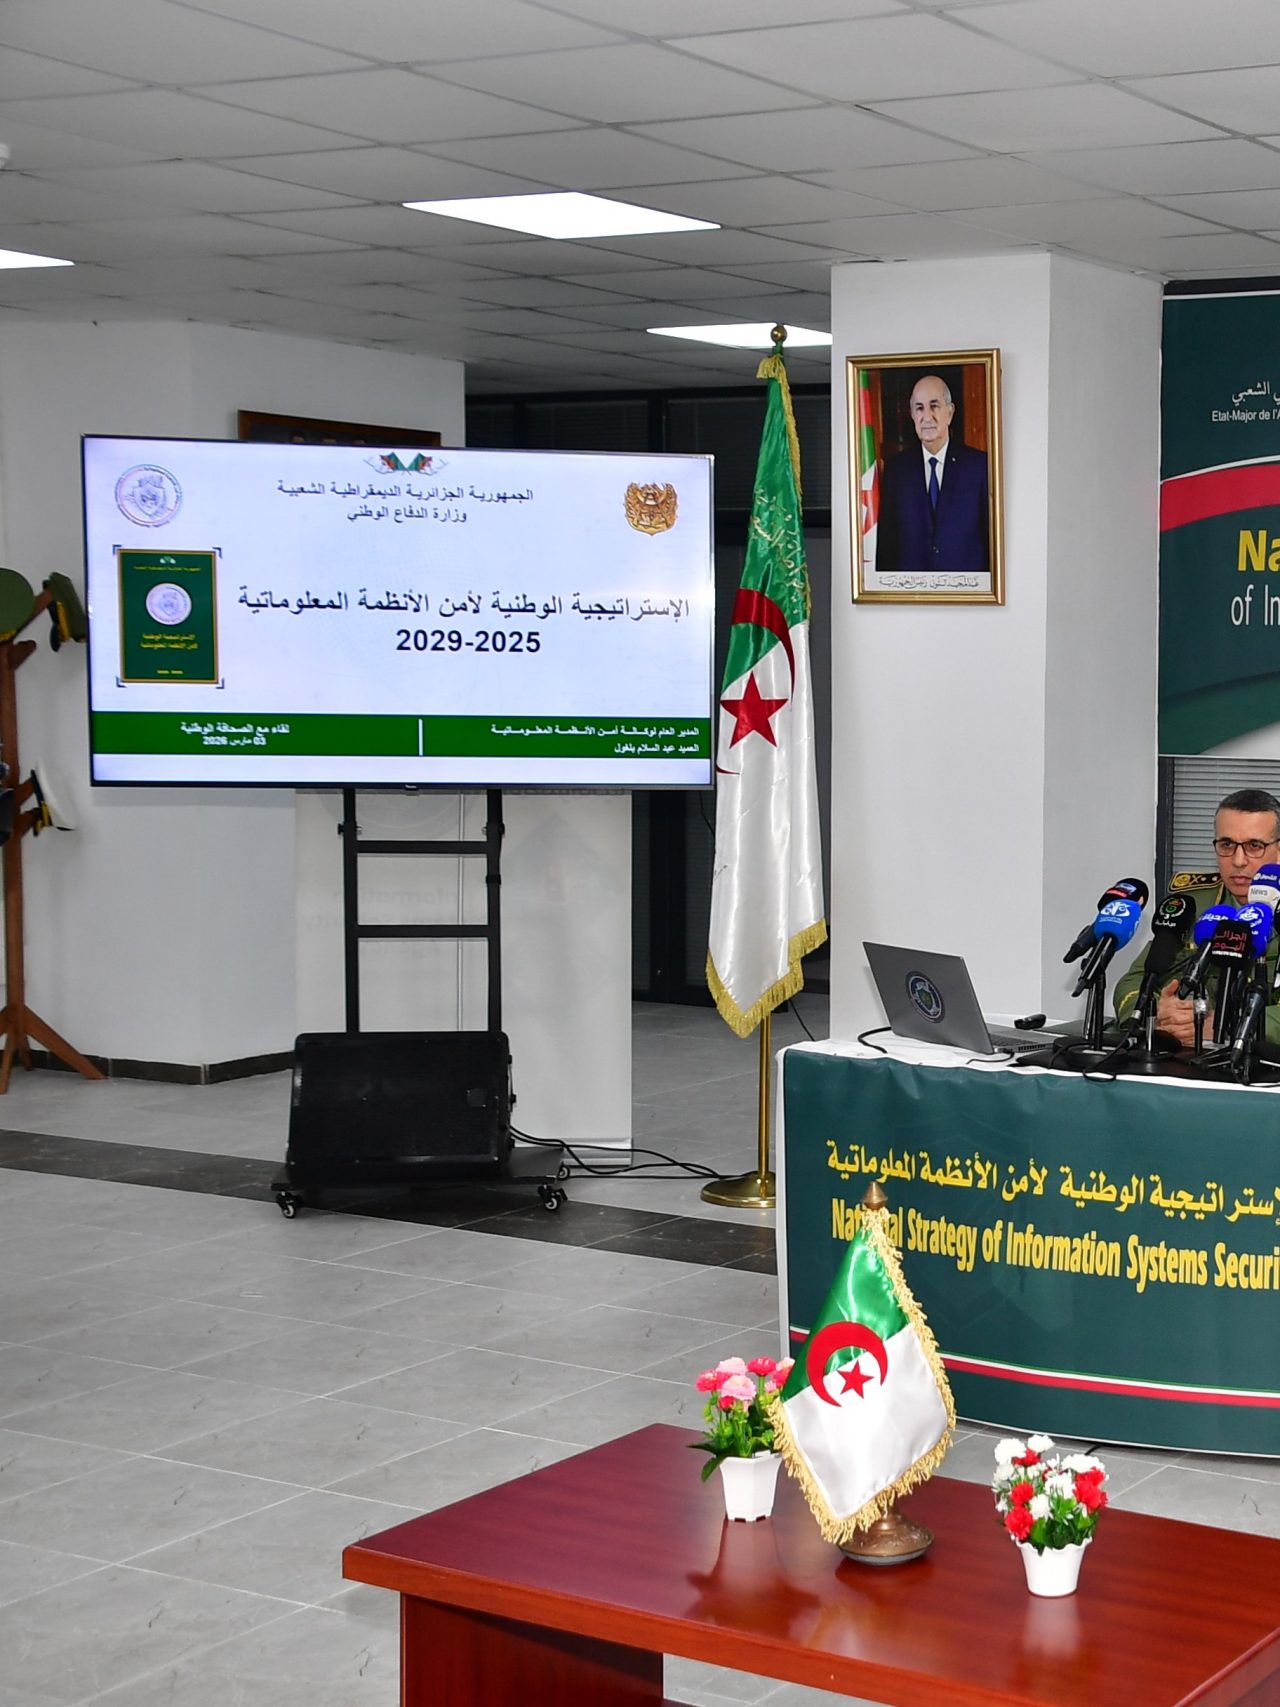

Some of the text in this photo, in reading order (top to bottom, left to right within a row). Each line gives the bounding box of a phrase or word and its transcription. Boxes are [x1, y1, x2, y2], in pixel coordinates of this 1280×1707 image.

[1232, 381, 1271, 406] الشعبي
[1212, 409, 1258, 423] Etat-Major
[1259, 408, 1271, 420] de
[277, 479, 533, 504] الجمهورية الجزائرية الديمقراطية الشعبية
[348, 504, 467, 523] وزارة الدفاع الوطني
[238, 585, 691, 623] الإستراتيجية الوطنية لأمن الأنظمة المعلوماتية
[1230, 583, 1255, 627] of
[396, 628, 541, 653] 2029-2025
[1250, 887, 1268, 896] News
[826, 1139, 915, 1184] المعلوماتية
[919, 1150, 998, 1190] الأنظمة
[1001, 1157, 1049, 1202] لأمن
[1059, 1165, 1145, 1213] الوطنية
[907, 1206, 978, 1273] Strategy
[982, 1219, 1003, 1264] of
[1006, 1220, 1121, 1279] Information
[1126, 1233, 1208, 1294] Systems
